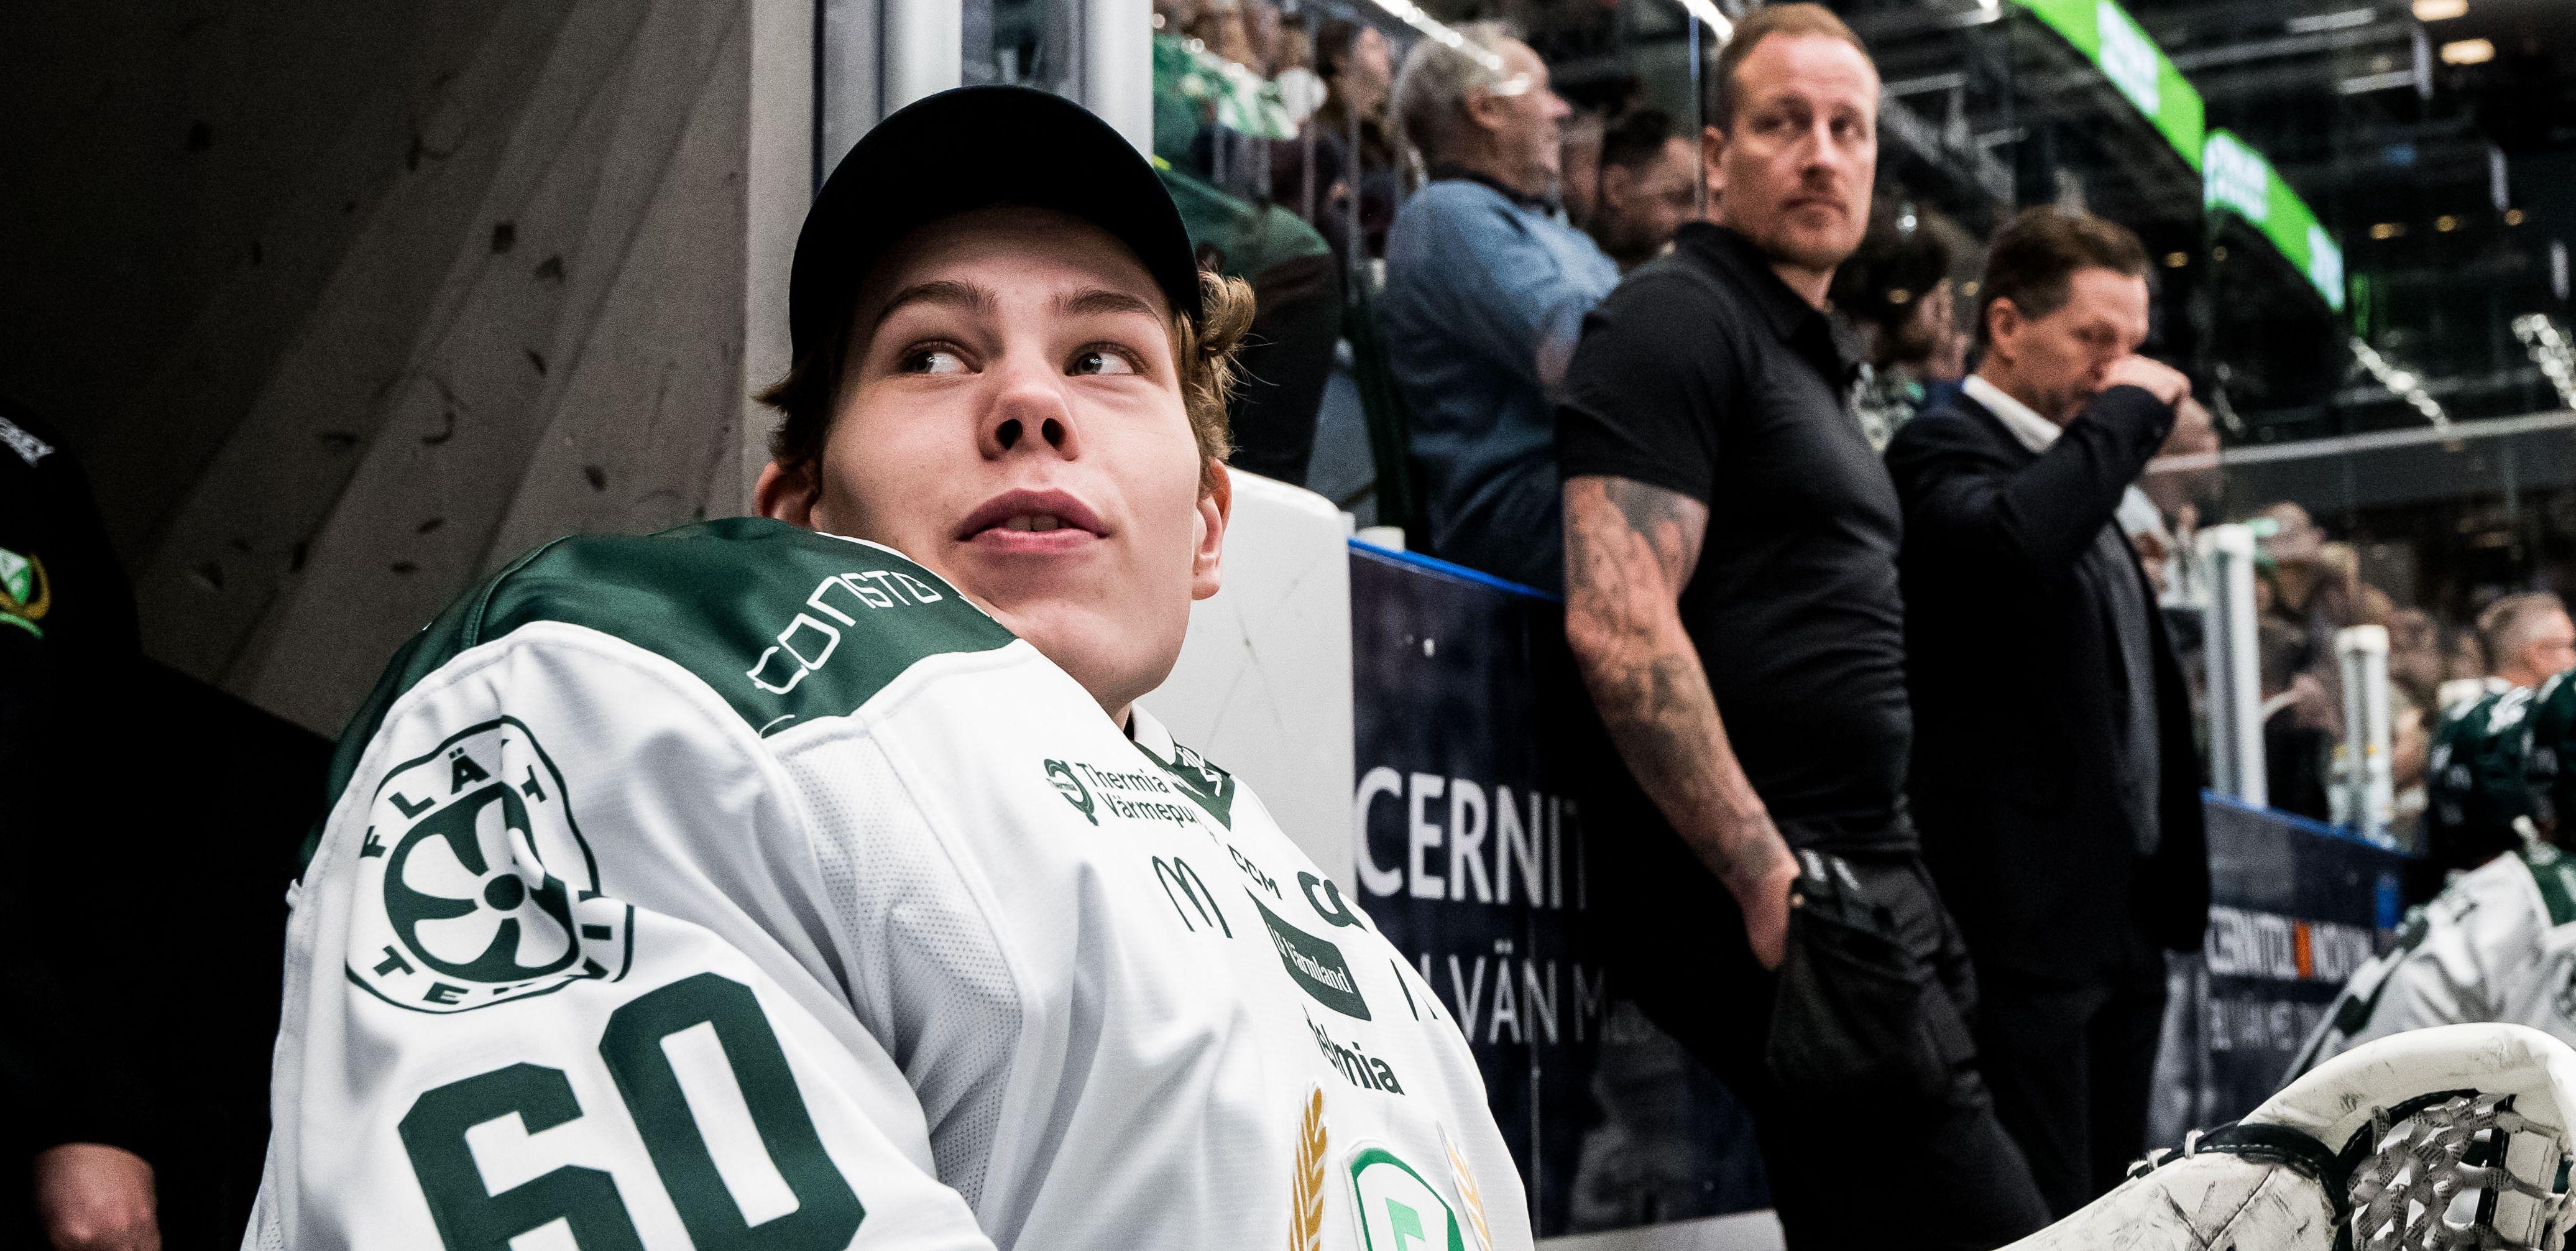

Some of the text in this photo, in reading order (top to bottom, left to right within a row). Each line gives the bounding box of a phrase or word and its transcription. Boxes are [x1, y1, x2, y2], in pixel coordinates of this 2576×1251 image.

[359, 738, 548, 859] FLÄT
[1075, 762, 1171, 794] Thermia
[1097, 792, 1203, 828] Värmepu
[1226, 843, 1283, 901] CCM
[1447, 938, 1558, 1045] VÄN
[397, 971, 867, 1251] 60
